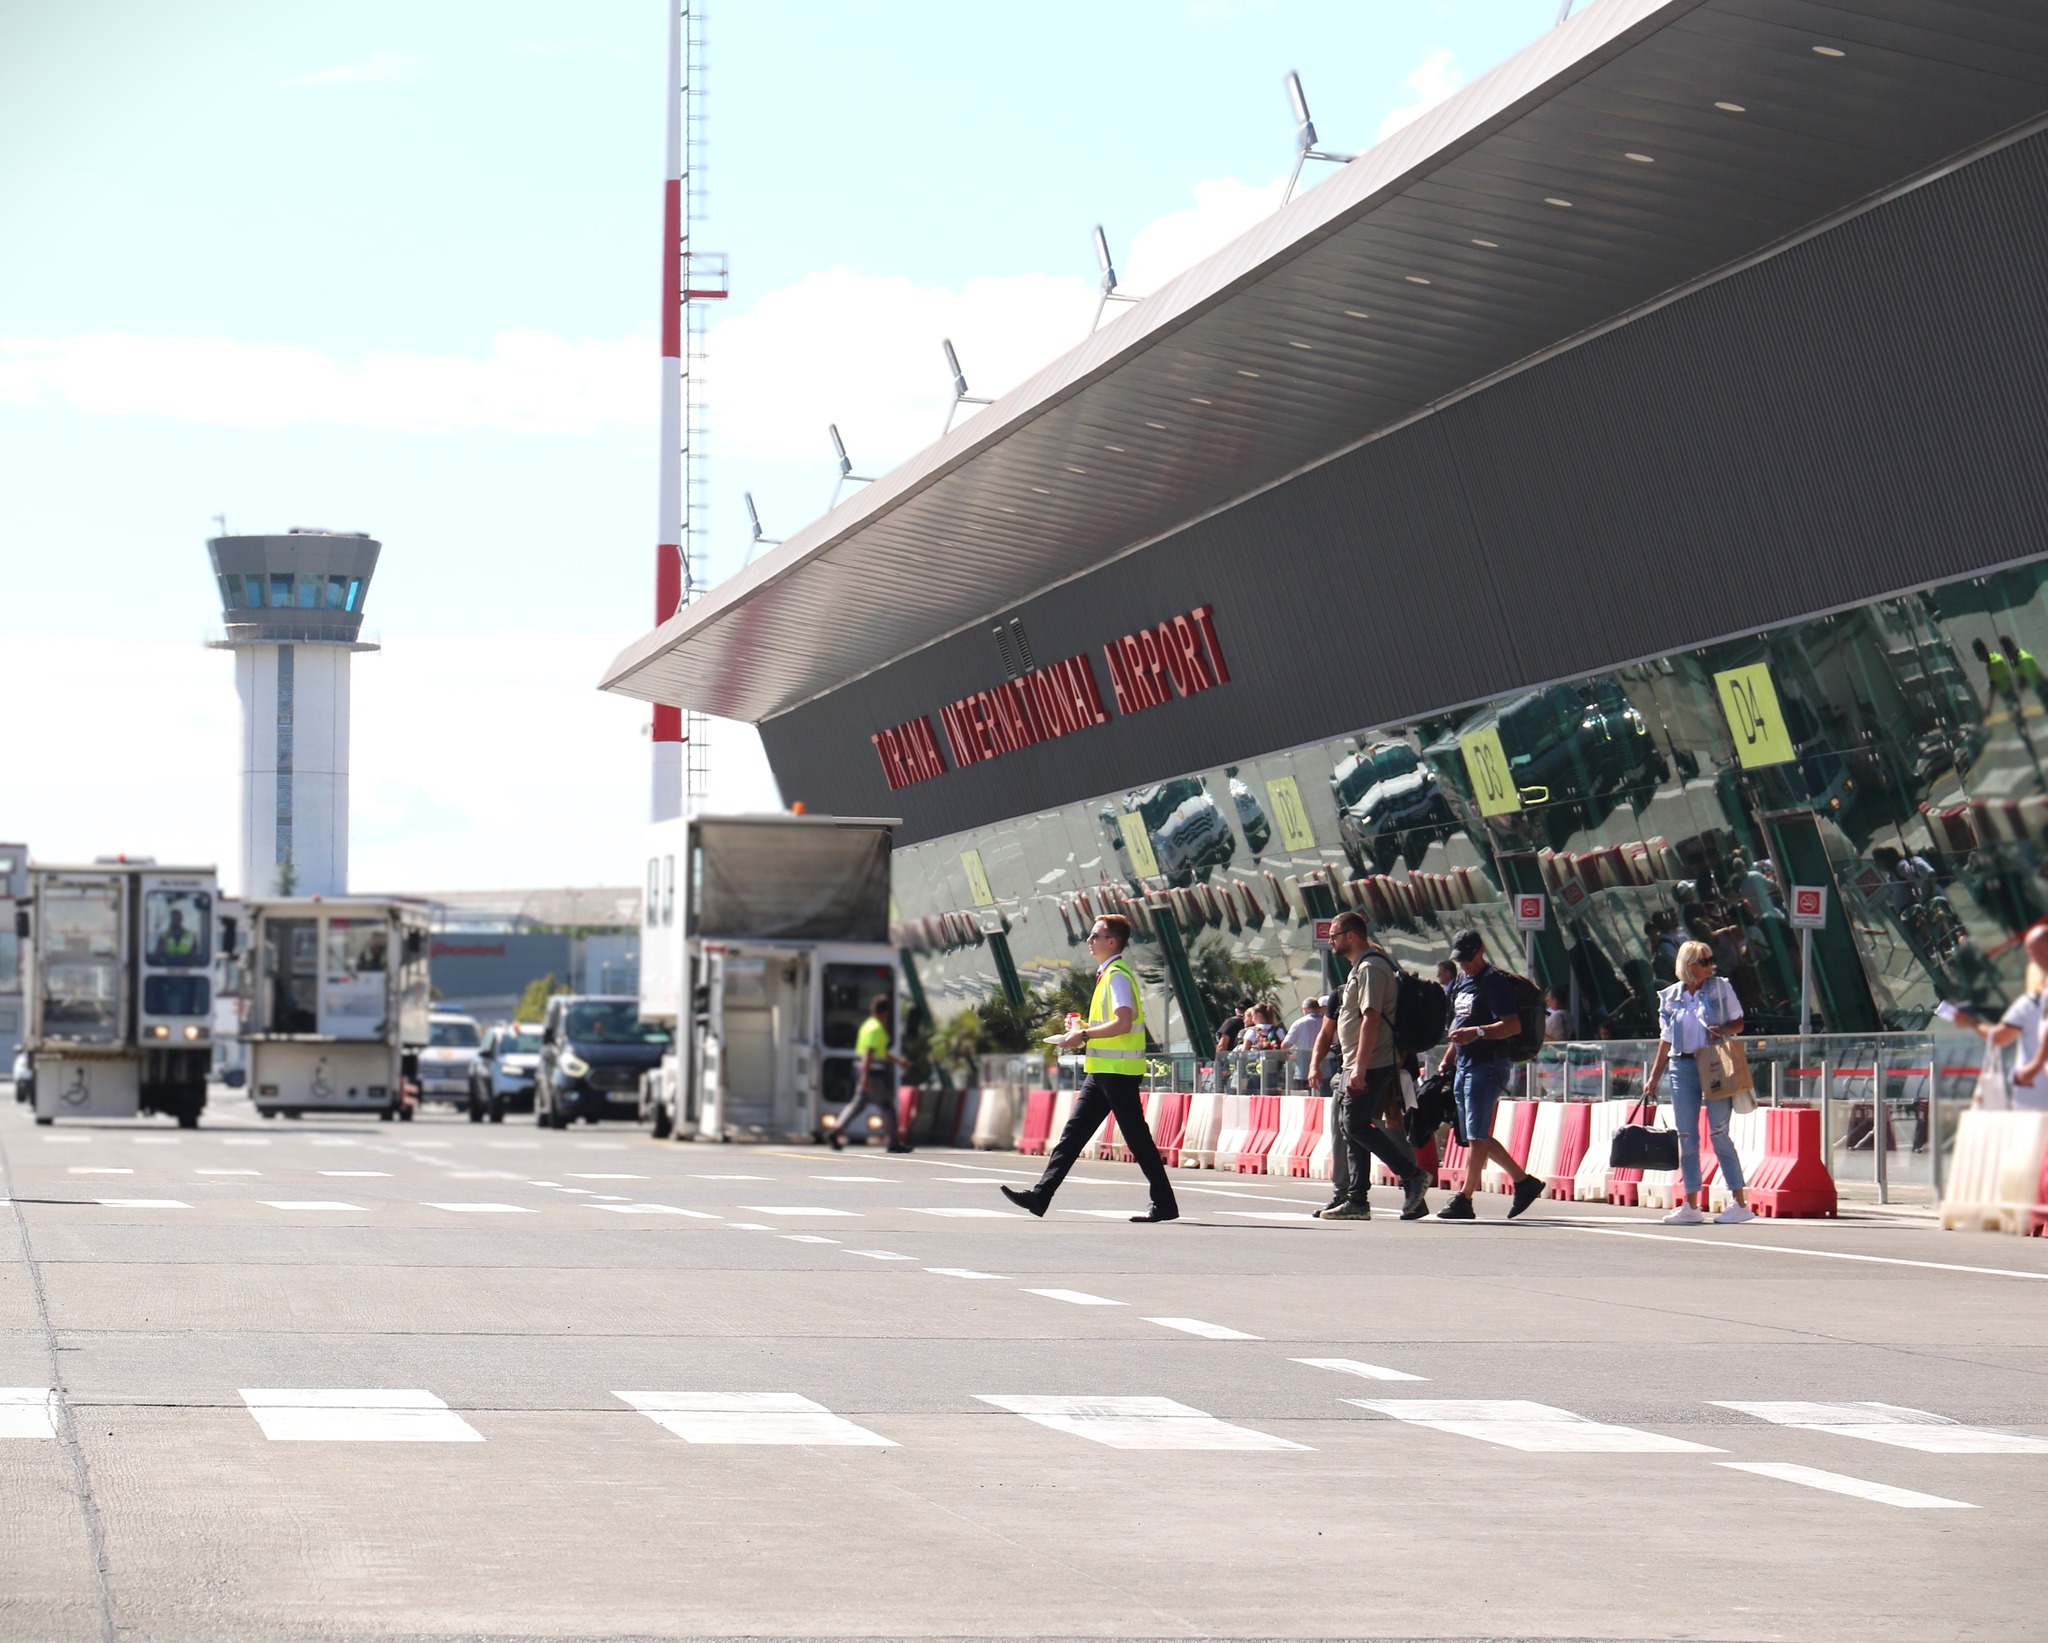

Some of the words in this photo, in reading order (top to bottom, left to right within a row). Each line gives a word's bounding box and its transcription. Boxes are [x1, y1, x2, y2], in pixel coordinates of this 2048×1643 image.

[870, 715, 949, 791] TIRANA
[938, 653, 1112, 768] INTERNATIONAL
[1103, 604, 1230, 715] AIRPORT
[1729, 675, 1769, 745] D4
[1473, 743, 1504, 801] D3
[1278, 788, 1304, 839] D2
